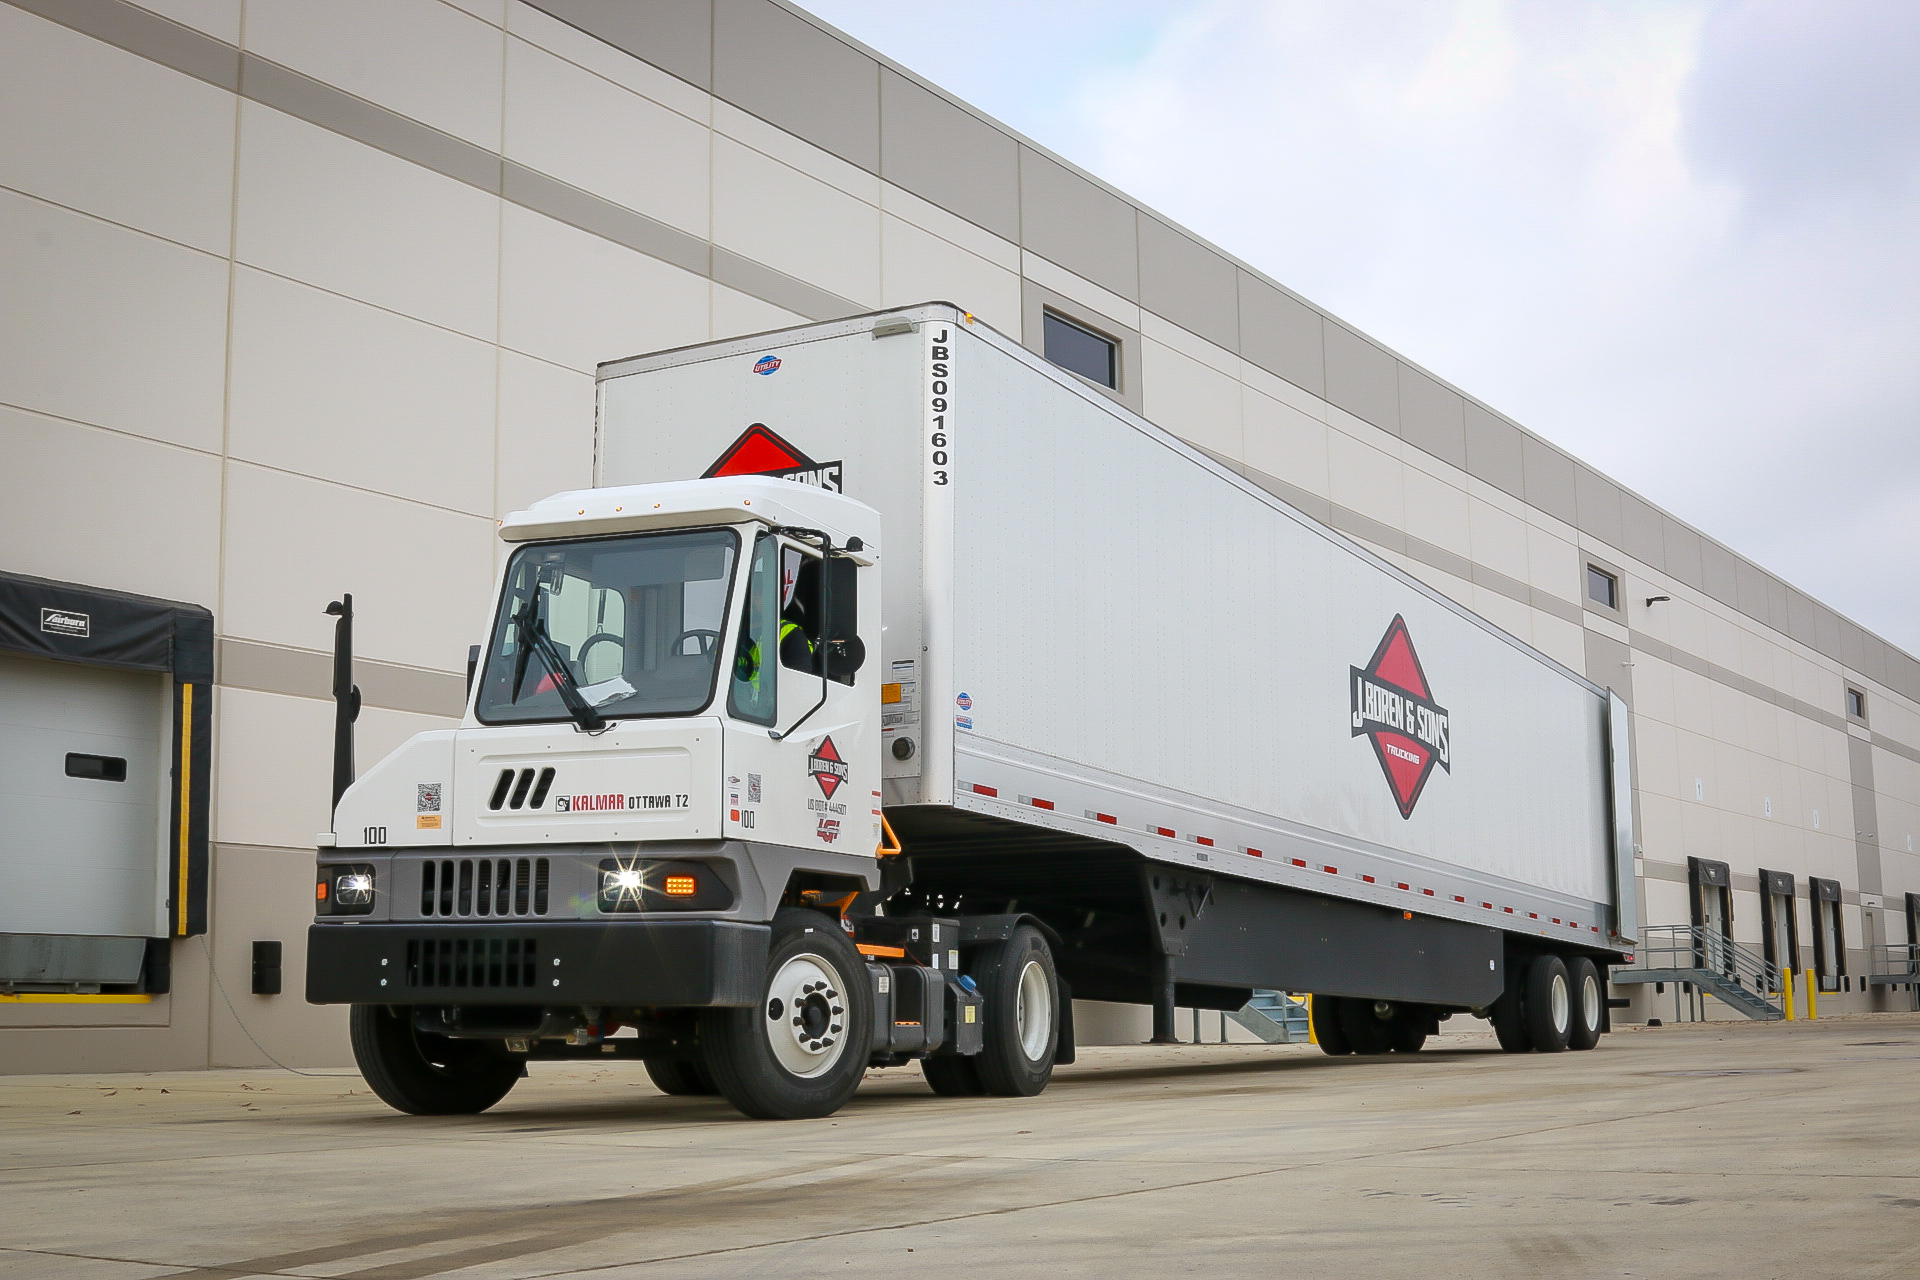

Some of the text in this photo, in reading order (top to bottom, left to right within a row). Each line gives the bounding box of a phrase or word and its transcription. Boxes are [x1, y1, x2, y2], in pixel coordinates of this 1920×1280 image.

[755, 360, 780, 372] UTILITY
[931, 329, 949, 486] JBS091603
[1405, 698, 1415, 735] &
[1416, 704, 1449, 764] SONS
[1386, 743, 1420, 765] TRUCKING
[572, 793, 689, 811] KALMAR OTTAWA T2
[741, 809, 755, 829] 100
[363, 826, 387, 845] 100
